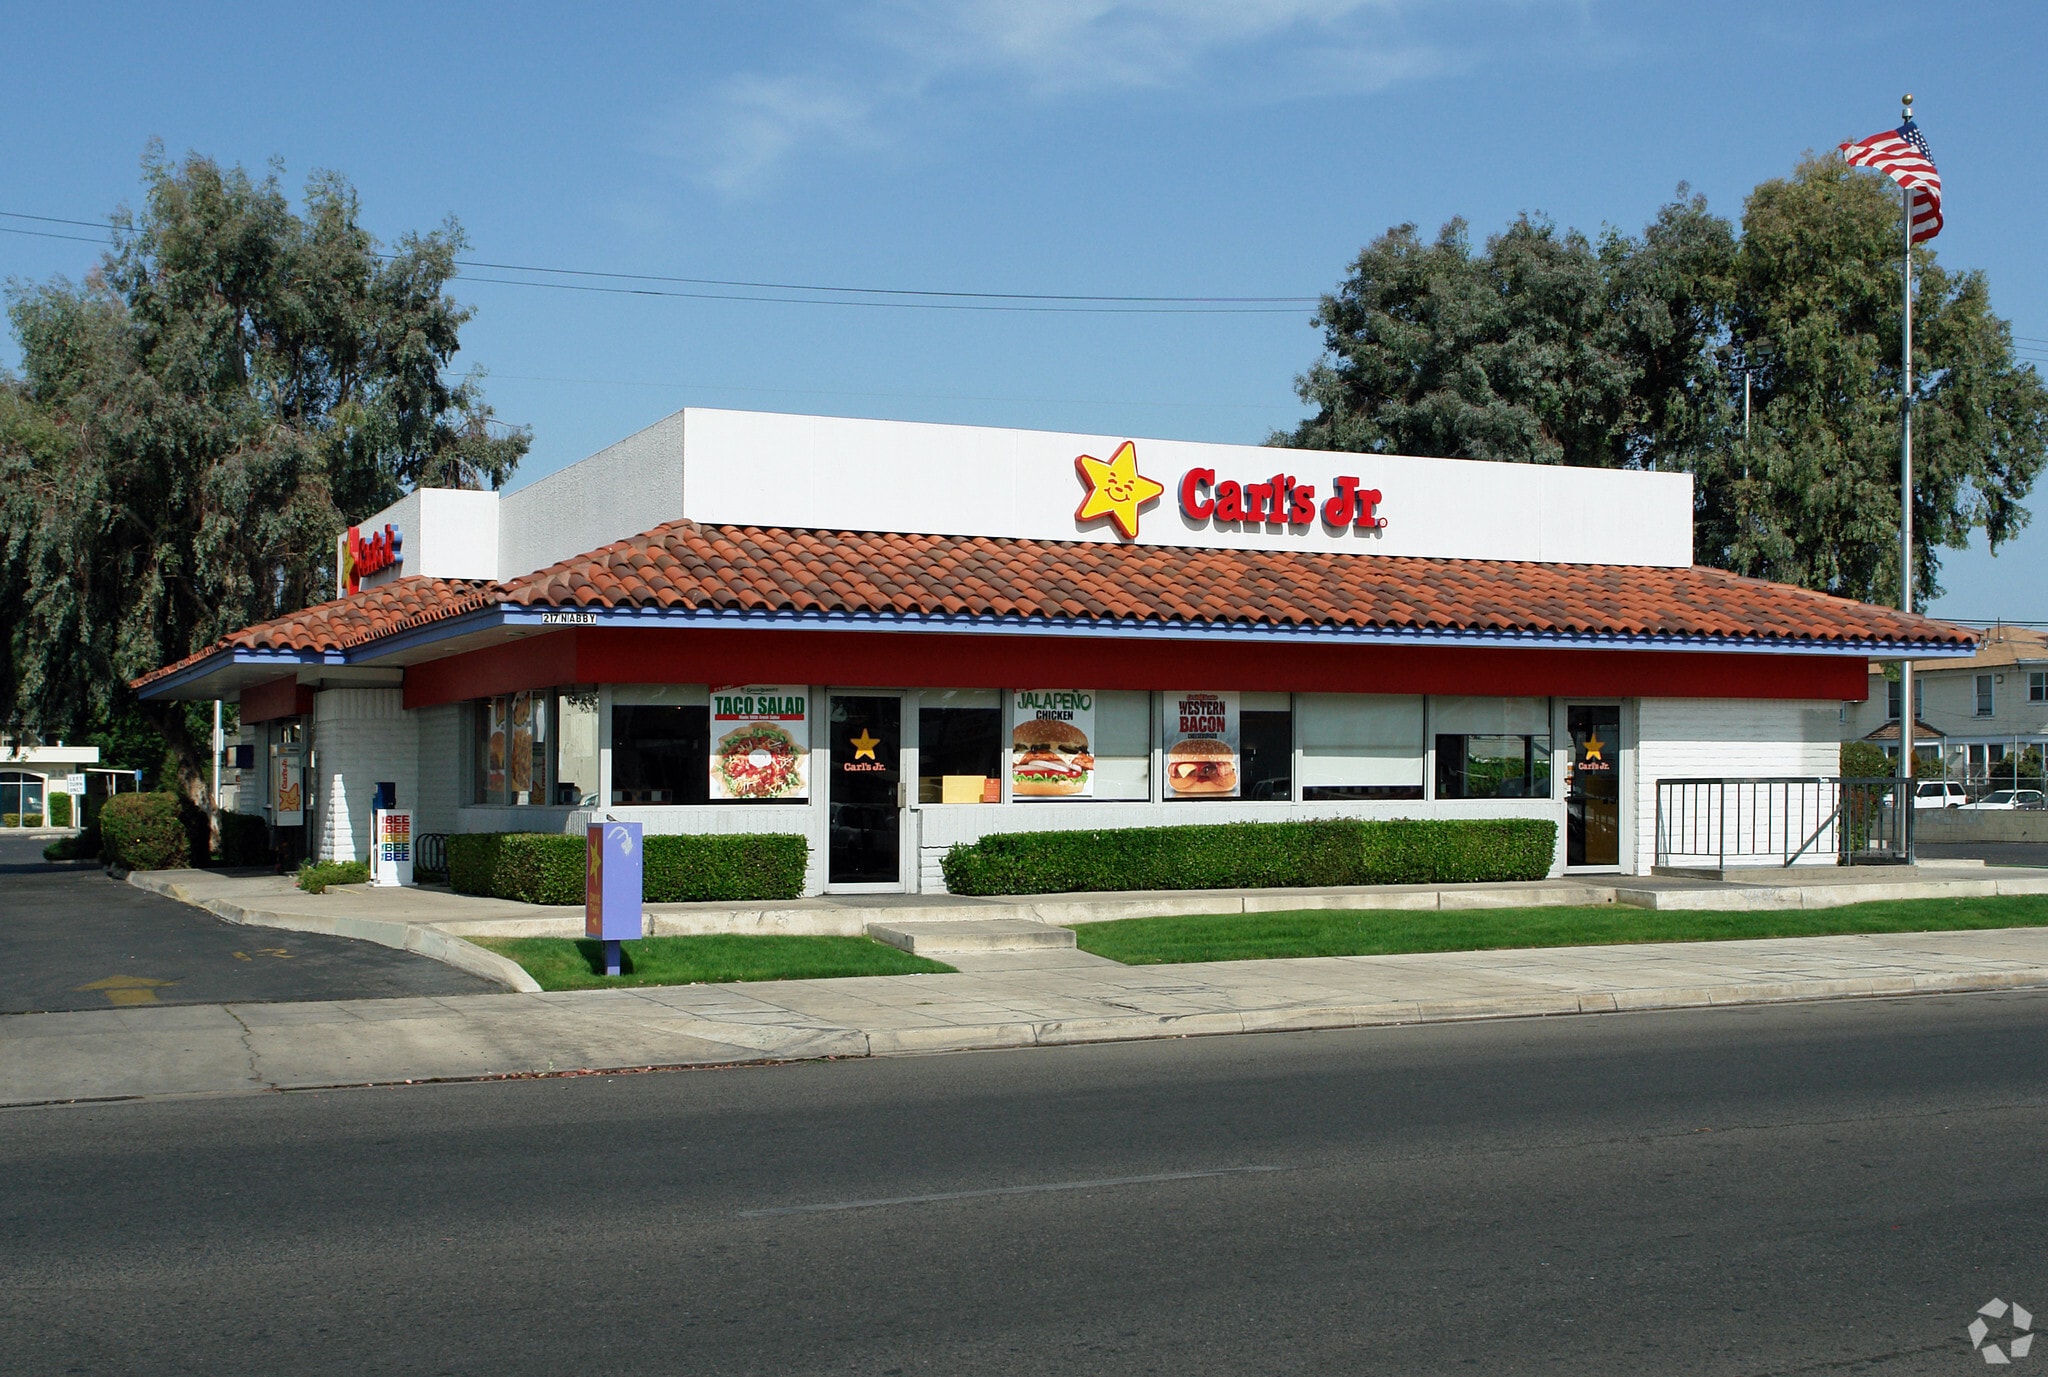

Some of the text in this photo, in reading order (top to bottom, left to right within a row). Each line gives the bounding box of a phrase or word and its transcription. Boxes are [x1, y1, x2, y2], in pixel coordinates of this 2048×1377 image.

[1178, 467, 1316, 525] Carl's
[543, 614, 595, 623] 217 N ABBY
[1017, 689, 1092, 712] JALAPEÑO
[715, 696, 805, 715] TACO SALAD
[1179, 700, 1226, 716] WESTERN
[1036, 710, 1074, 721] CHICKEN
[1179, 716, 1226, 733] BACON
[843, 762, 886, 771] Carl's Jr.
[1578, 762, 1599, 770] Carl's
[385, 815, 410, 824] BEE
[385, 824, 410, 833] BEE
[385, 833, 410, 842] BEE
[385, 843, 410, 851] BEE
[385, 852, 410, 861] BEE
